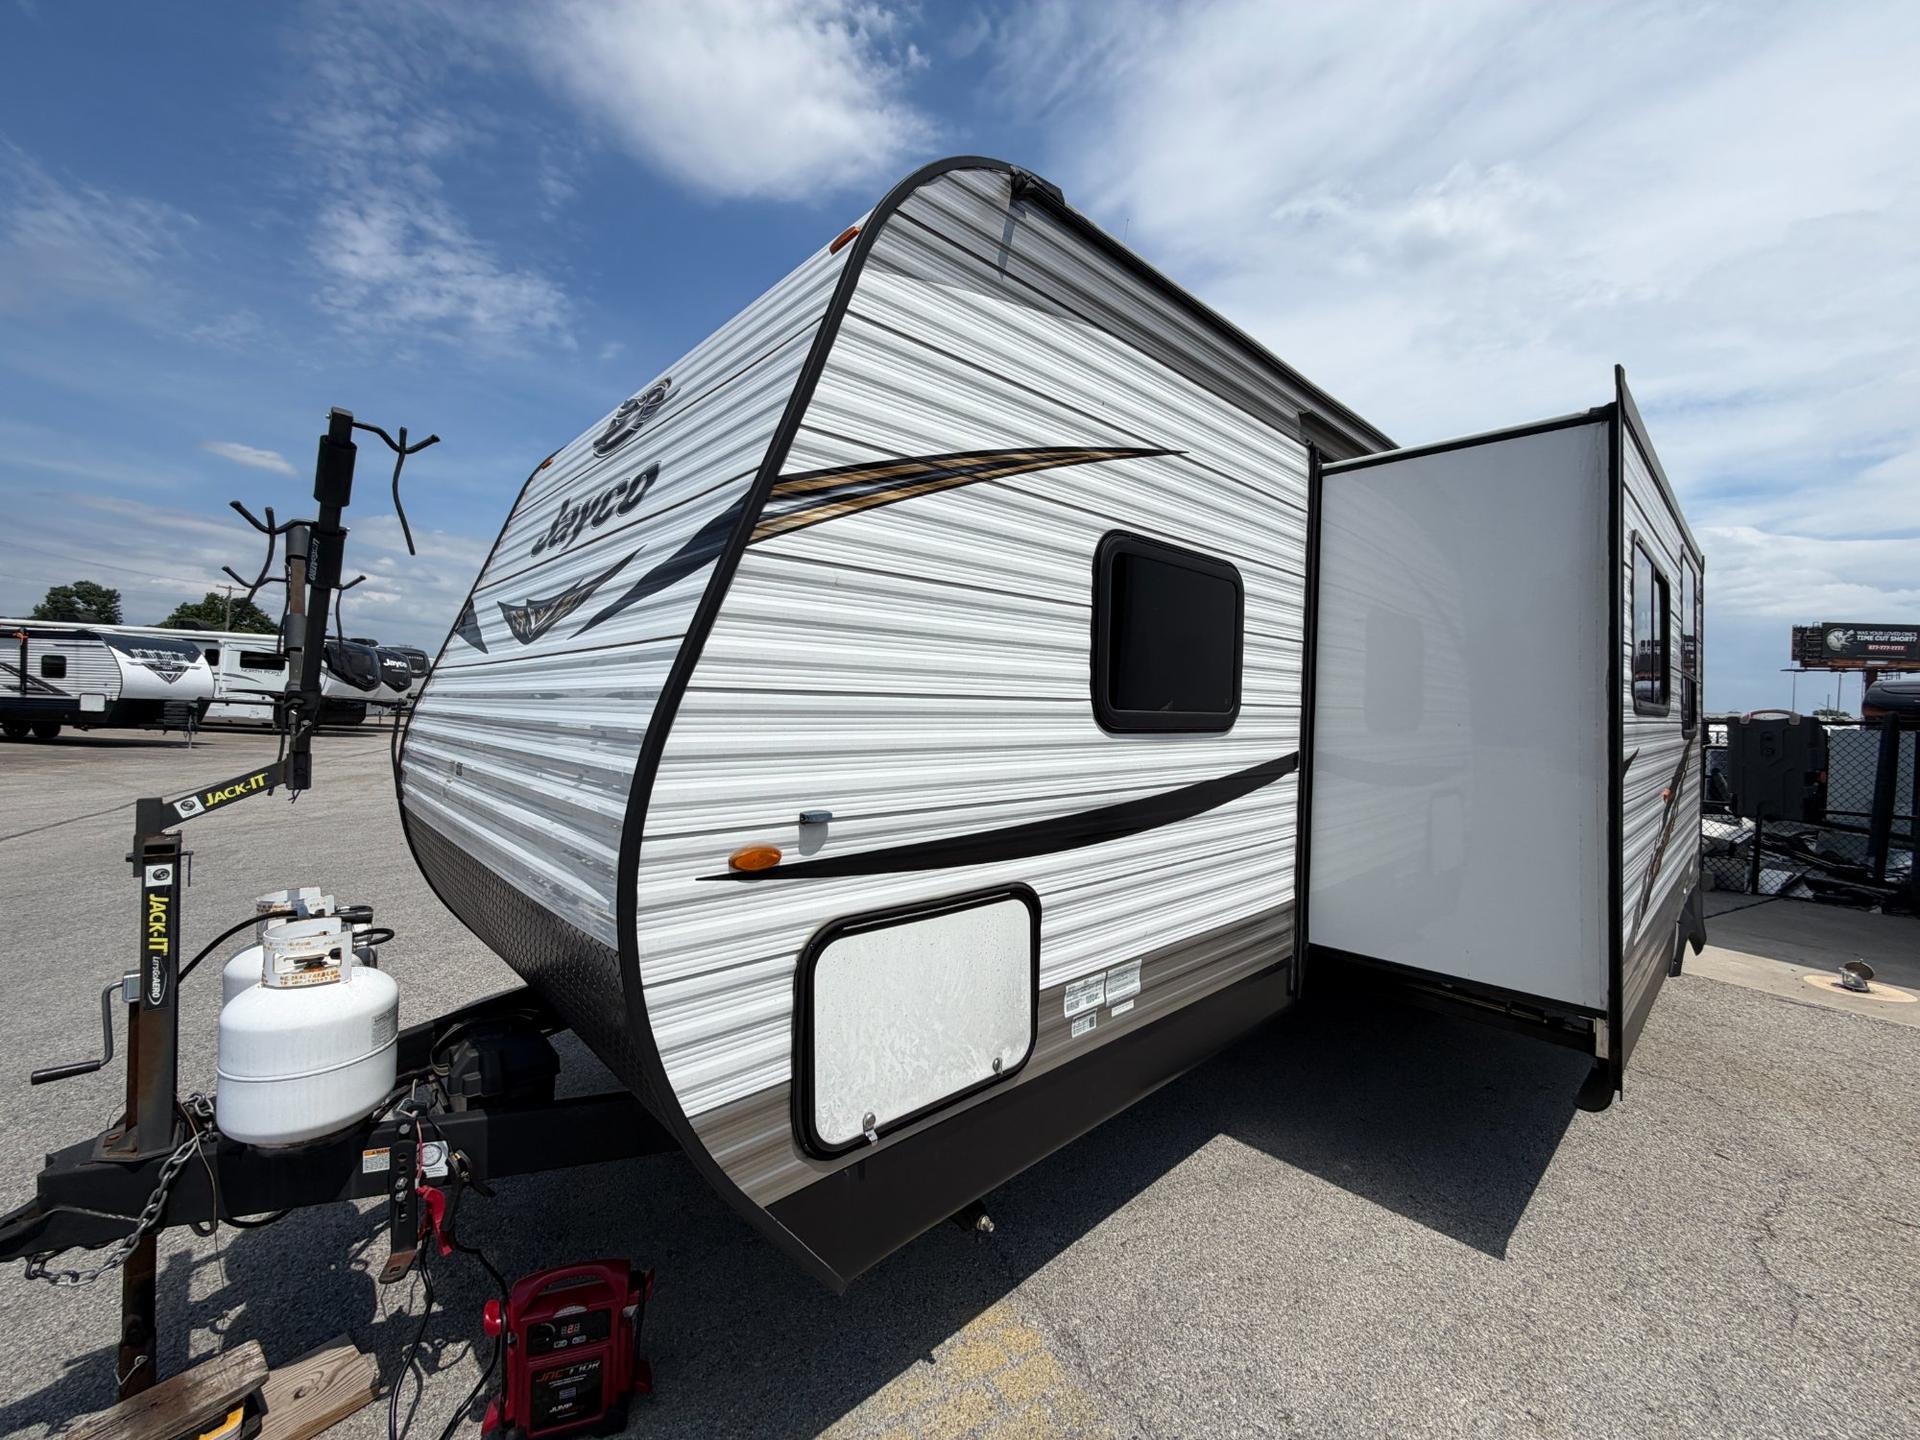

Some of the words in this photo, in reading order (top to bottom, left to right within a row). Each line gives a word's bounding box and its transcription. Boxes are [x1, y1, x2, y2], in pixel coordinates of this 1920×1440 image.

[530, 461, 661, 557] Jayco
[383, 658, 408, 668] Jayco
[205, 773, 267, 807] JACK-IT
[148, 893, 169, 953] JACK-IT
